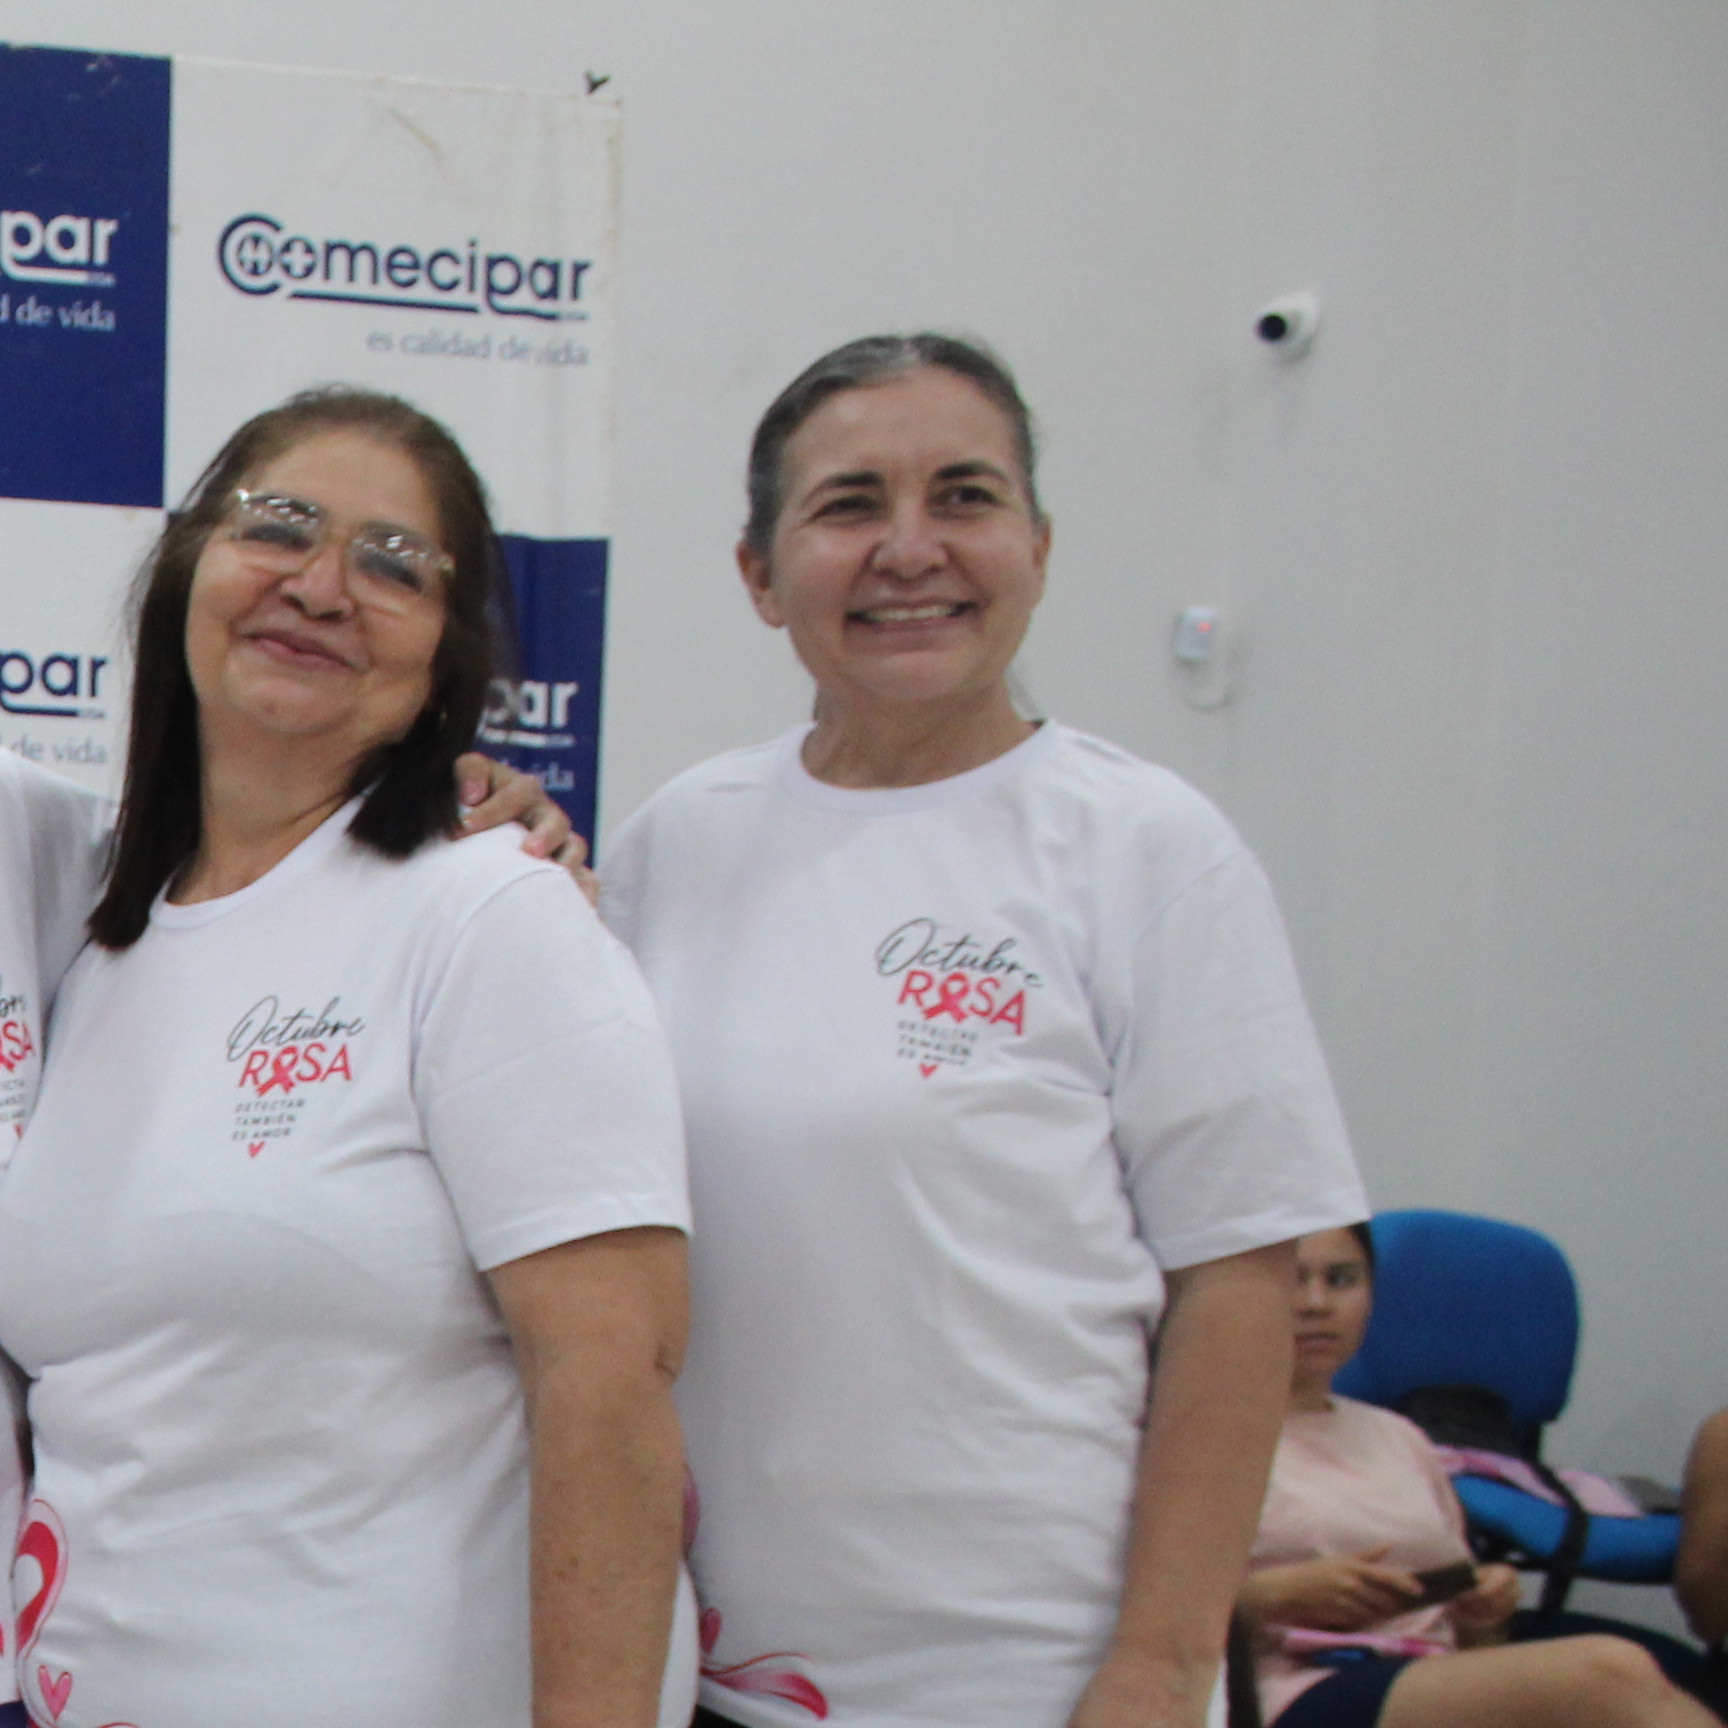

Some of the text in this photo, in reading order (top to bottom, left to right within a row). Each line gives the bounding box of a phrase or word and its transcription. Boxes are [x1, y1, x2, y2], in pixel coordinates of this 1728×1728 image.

[217, 212, 592, 321] Comecipar
[15, 295, 52, 327] de
[58, 300, 116, 331] vida
[51, 735, 107, 764] vida
[875, 917, 1044, 987] Octubre
[227, 995, 366, 1062] Octubre
